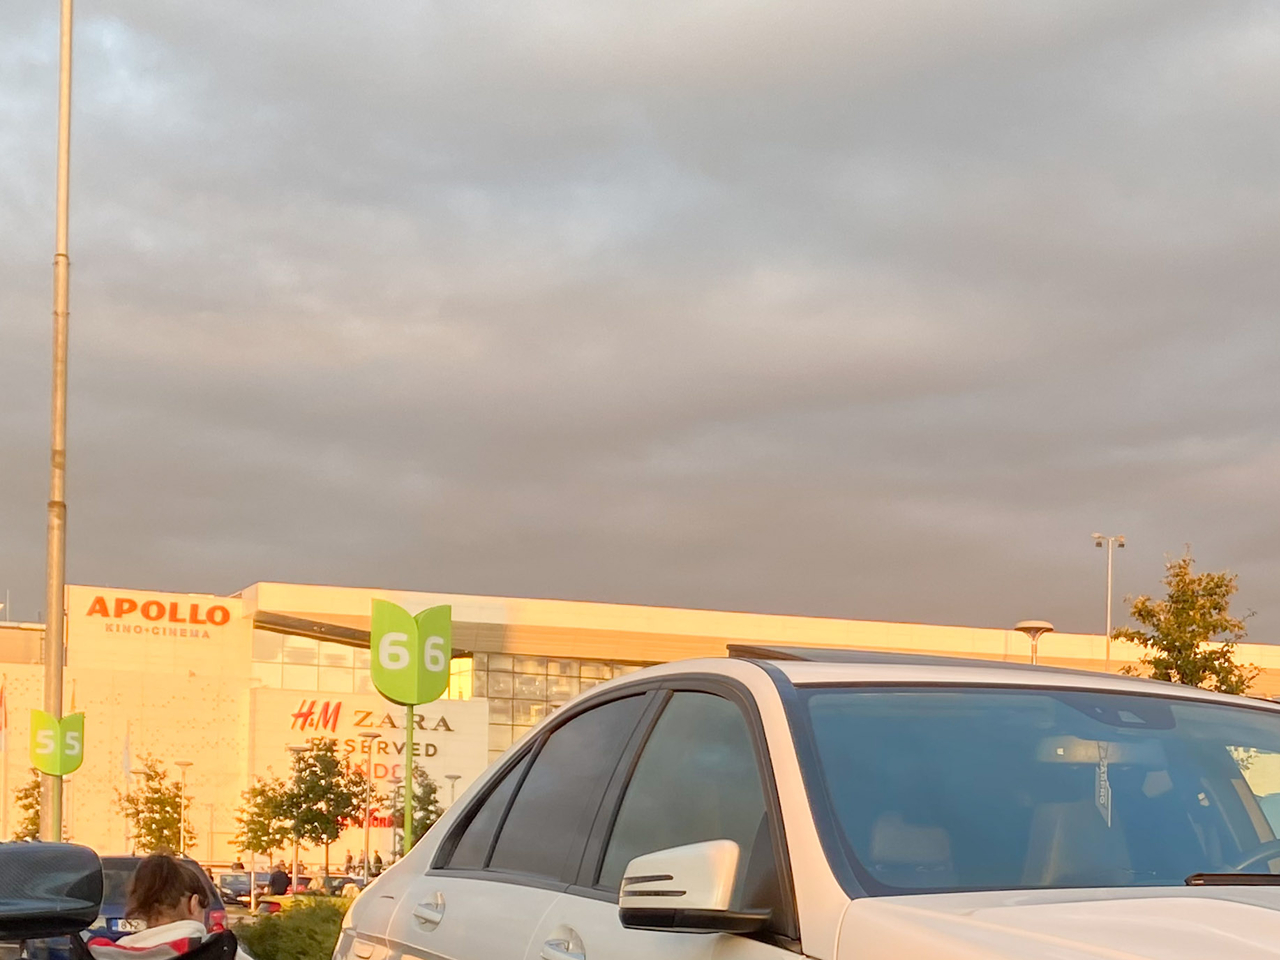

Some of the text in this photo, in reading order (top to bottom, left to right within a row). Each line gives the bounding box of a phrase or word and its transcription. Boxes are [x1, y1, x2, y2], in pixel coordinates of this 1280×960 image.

[86, 595, 230, 626] APOLLO
[379, 631, 410, 670] 6
[424, 635, 445, 672] 6
[291, 698, 455, 733] H&M ZARA
[36, 729, 54, 754] 5
[64, 731, 81, 755] 5
